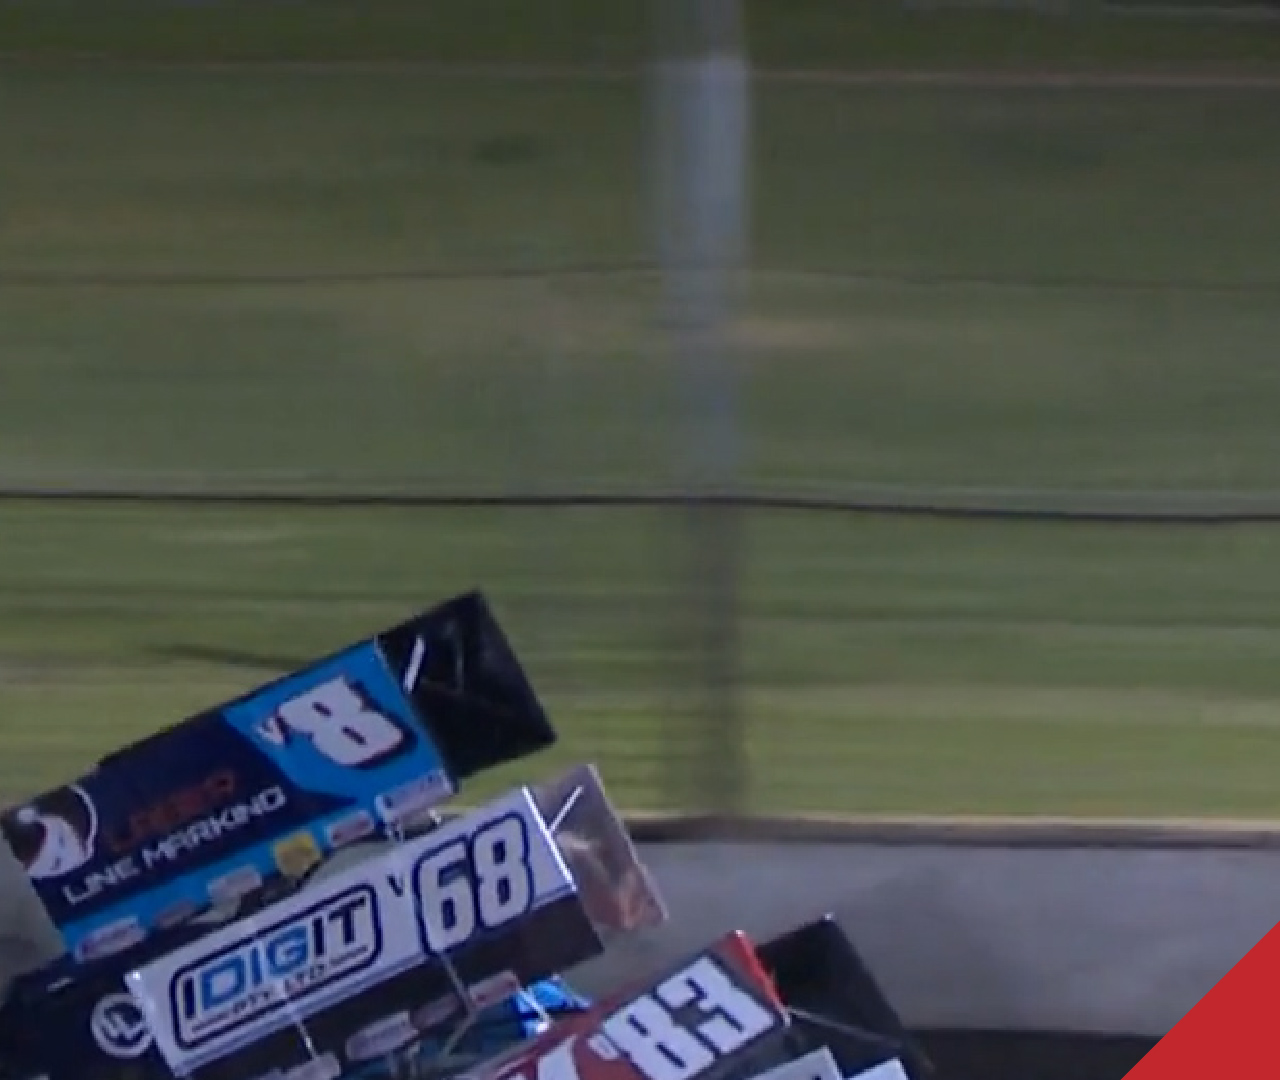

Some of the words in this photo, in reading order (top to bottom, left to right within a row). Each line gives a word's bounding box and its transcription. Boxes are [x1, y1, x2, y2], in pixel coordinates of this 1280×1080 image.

[277, 674, 406, 767] 8
[61, 860, 141, 906] LINE
[140, 785, 288, 872] MARKING
[413, 811, 535, 955] 68
[182, 896, 368, 1019] IDIGIT
